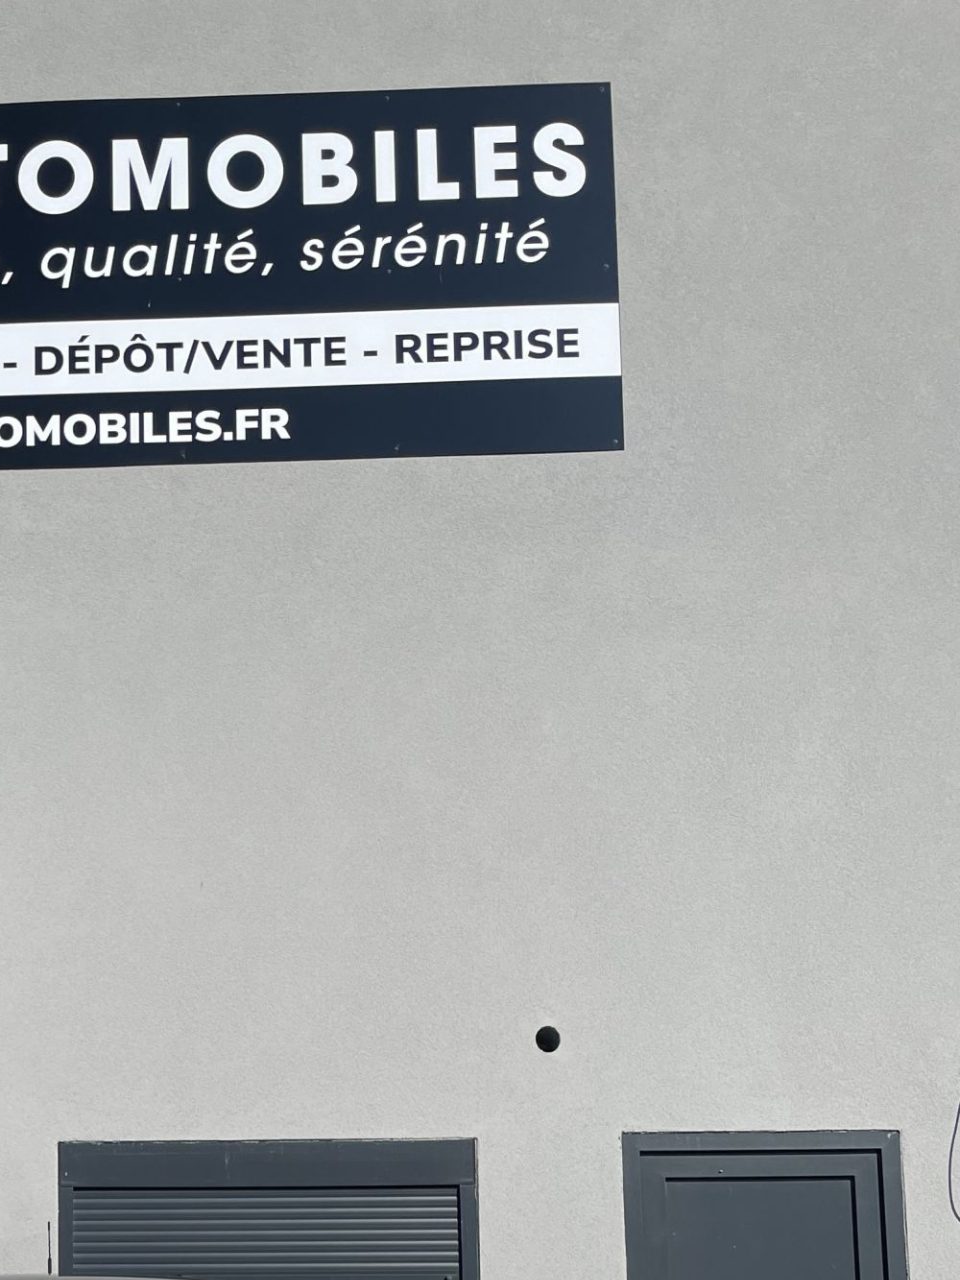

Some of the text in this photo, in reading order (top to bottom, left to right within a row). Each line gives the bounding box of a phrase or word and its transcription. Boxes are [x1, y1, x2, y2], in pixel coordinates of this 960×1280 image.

[40, 228, 274, 289] qualité,
[299, 218, 550, 271] sérénité
[34, 333, 347, 376] DÉPÔT/VENTE
[395, 328, 580, 364] REPRISE
